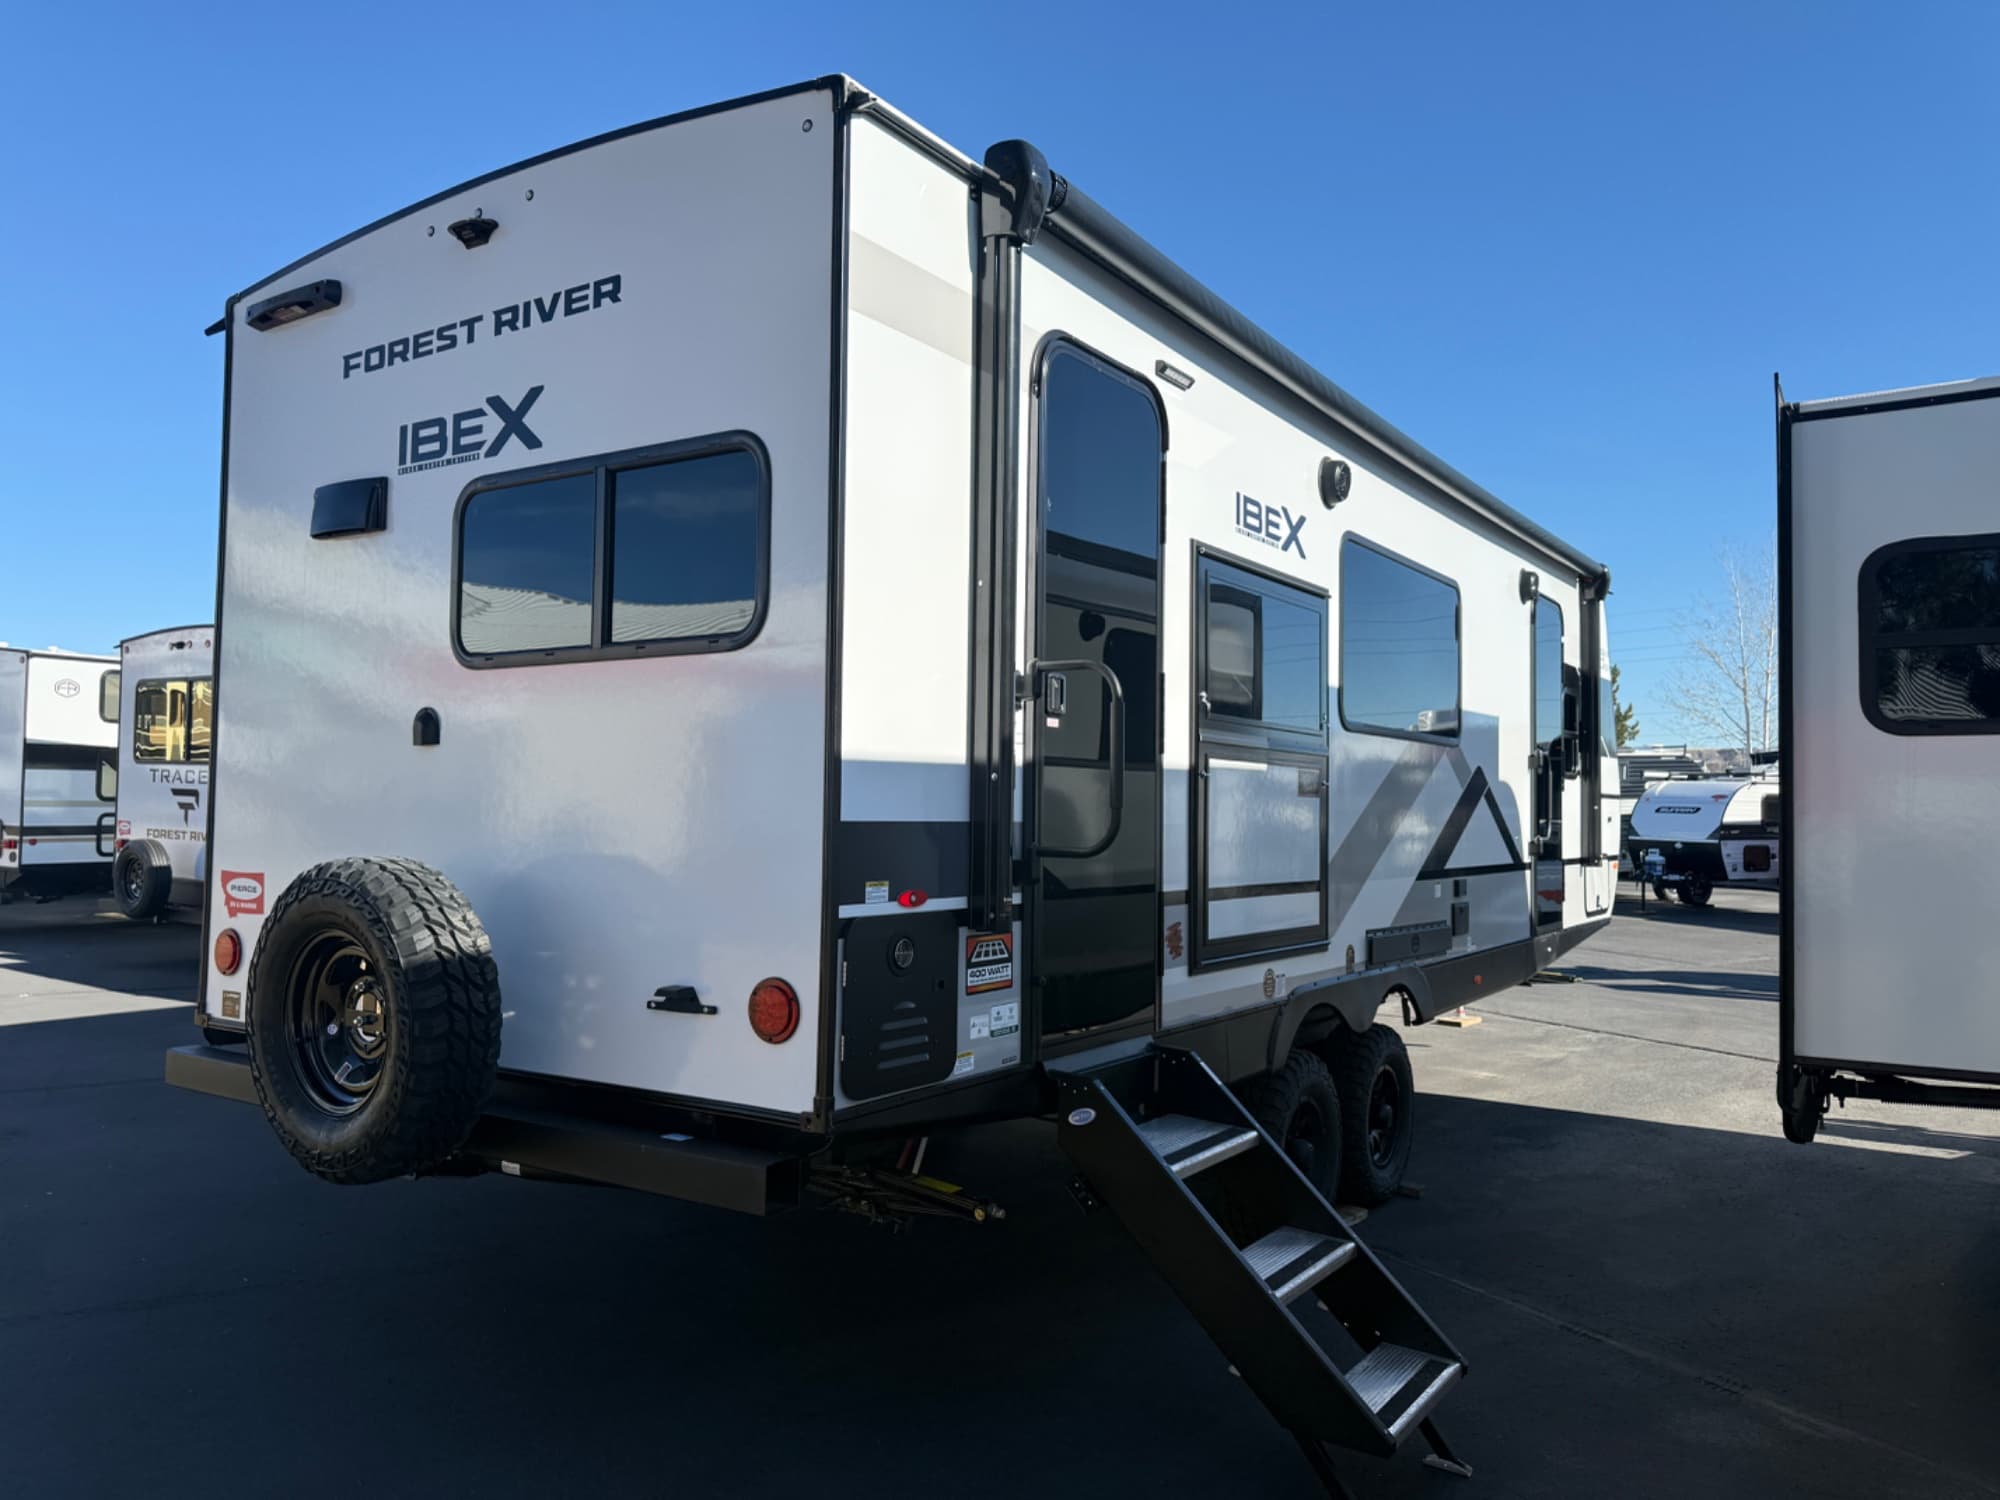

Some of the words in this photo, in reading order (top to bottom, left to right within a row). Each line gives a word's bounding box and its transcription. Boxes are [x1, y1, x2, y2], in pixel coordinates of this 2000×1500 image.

[342, 315, 484, 380] FOREST
[492, 274, 622, 337] RIVER
[398, 384, 545, 467] IBEX
[1236, 491, 1307, 560] IBEX
[149, 768, 208, 784] TRACE
[146, 828, 188, 840] FOREST
[969, 967, 986, 978] 400
[986, 965, 1010, 976] WATT
